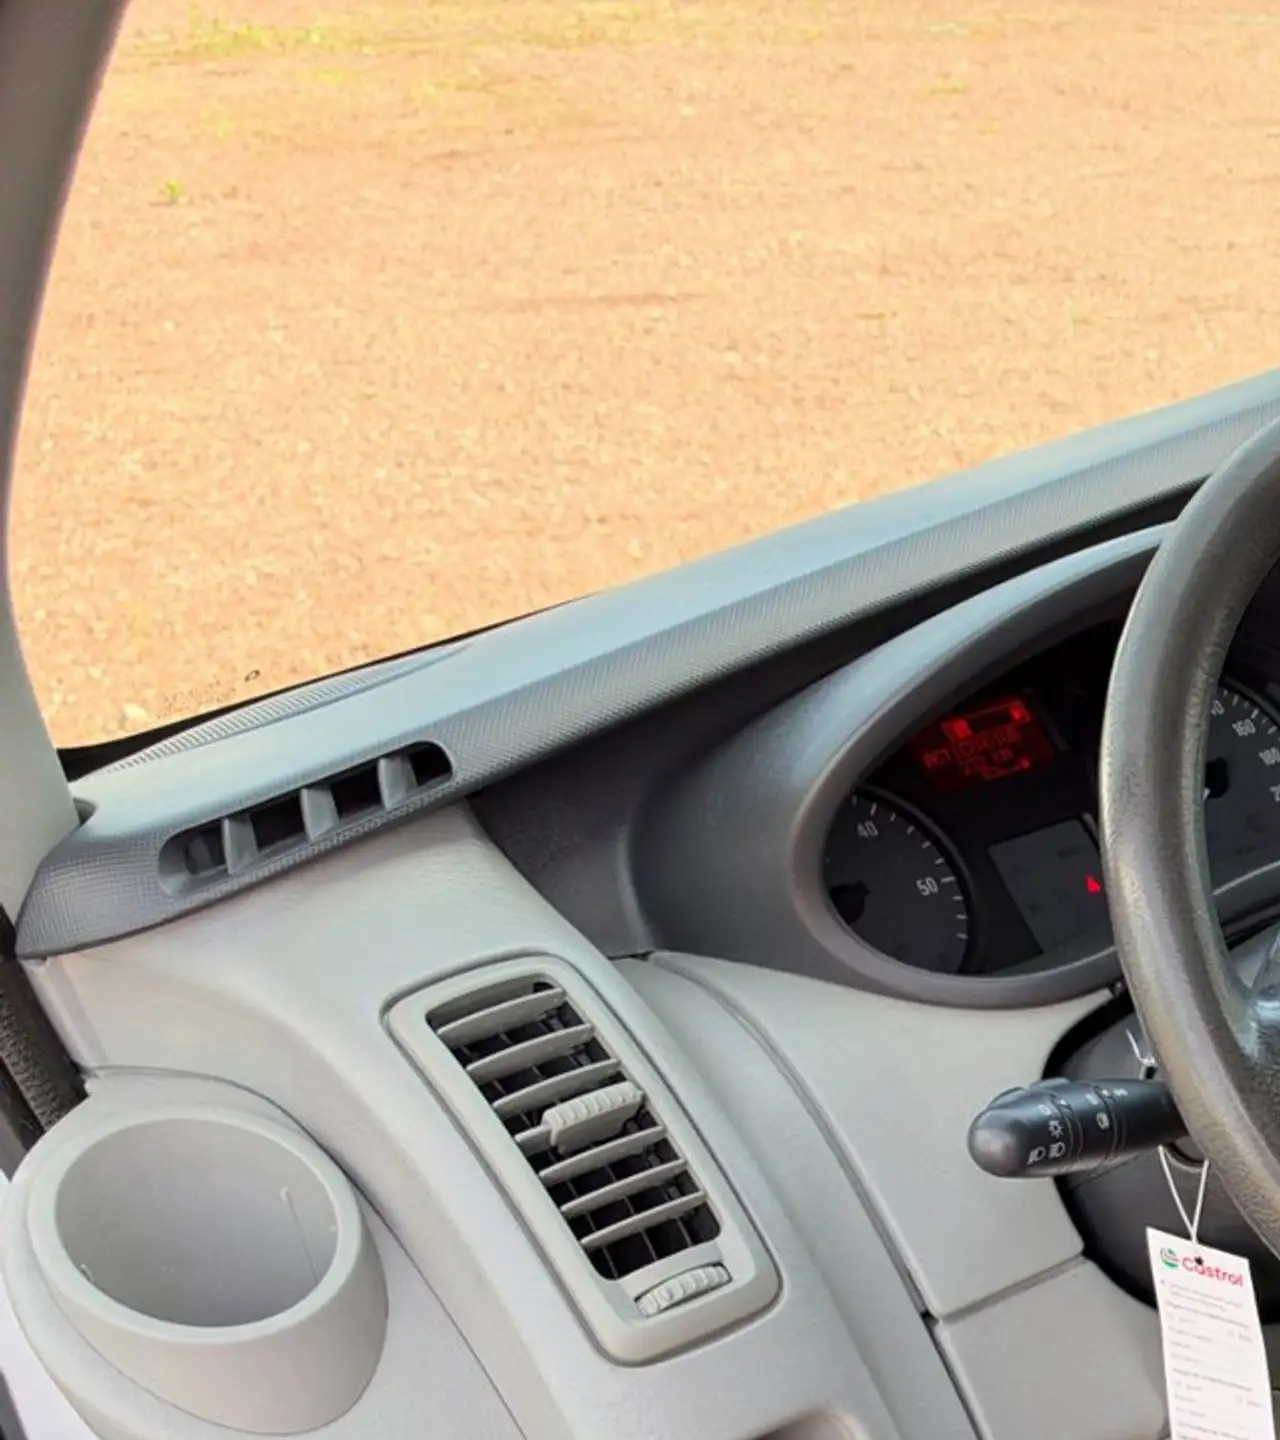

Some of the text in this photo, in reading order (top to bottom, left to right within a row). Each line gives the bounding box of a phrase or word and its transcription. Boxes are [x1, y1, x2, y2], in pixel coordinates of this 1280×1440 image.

[1231, 718, 1256, 738] 160
[857, 820, 879, 839] 40
[915, 876, 940, 897] 50
[1181, 1256, 1244, 1288] Castrol
